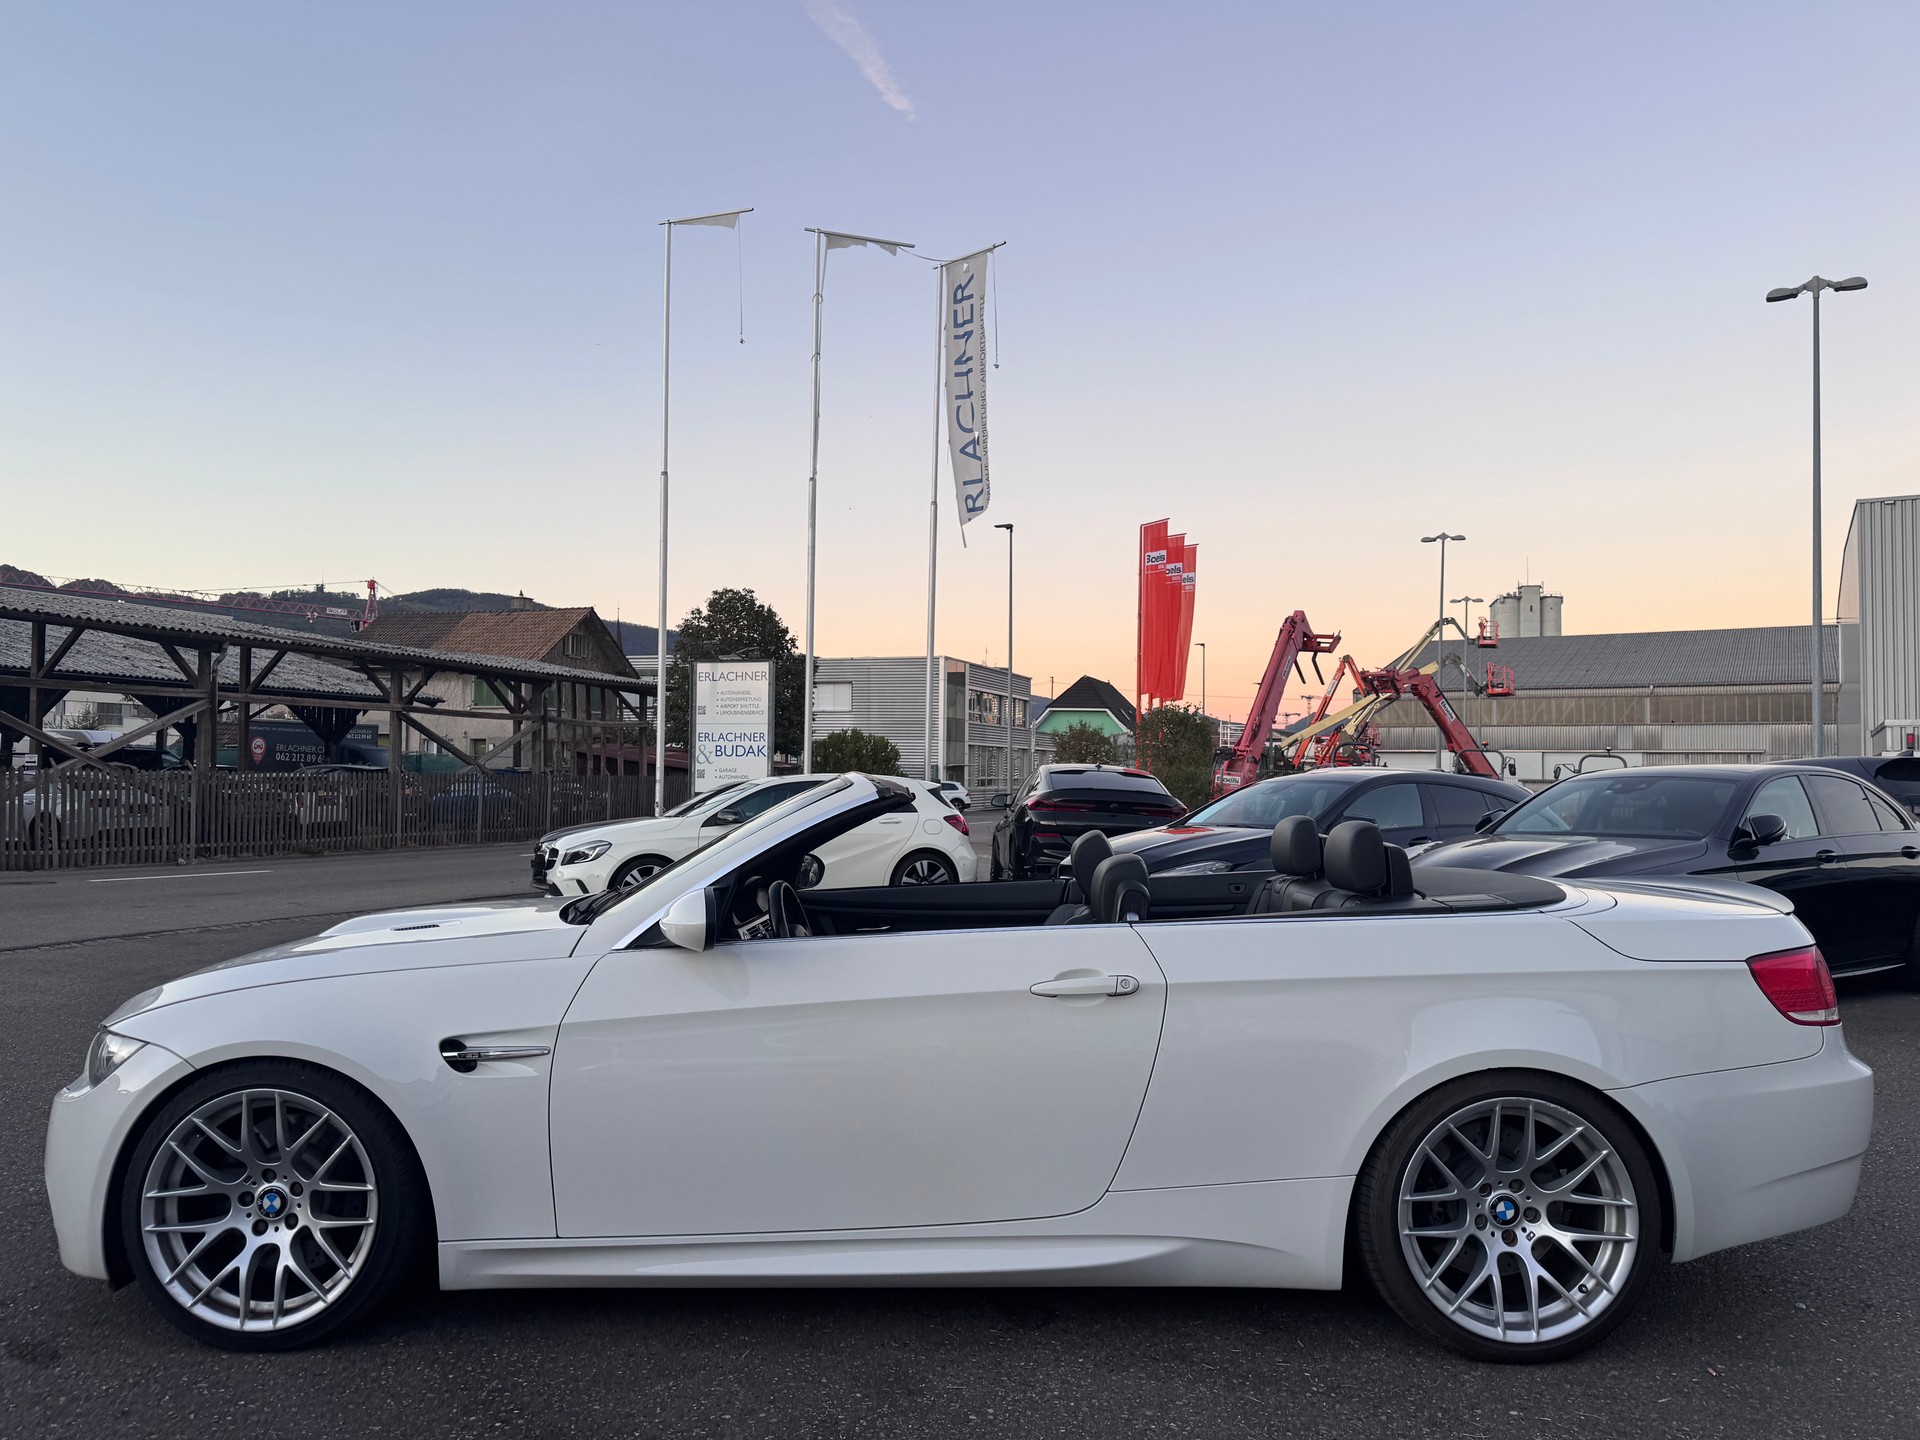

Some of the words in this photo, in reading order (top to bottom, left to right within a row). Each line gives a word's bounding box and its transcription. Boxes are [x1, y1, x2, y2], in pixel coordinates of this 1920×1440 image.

[698, 671, 768, 682] ERLACHNER
[698, 732, 766, 742] ERLACHNER
[275, 752, 290, 761] 062
[292, 753, 304, 762] 212
[306, 753, 316, 763] 89
[696, 744, 714, 765] &
[714, 744, 767, 758] BUDAK
